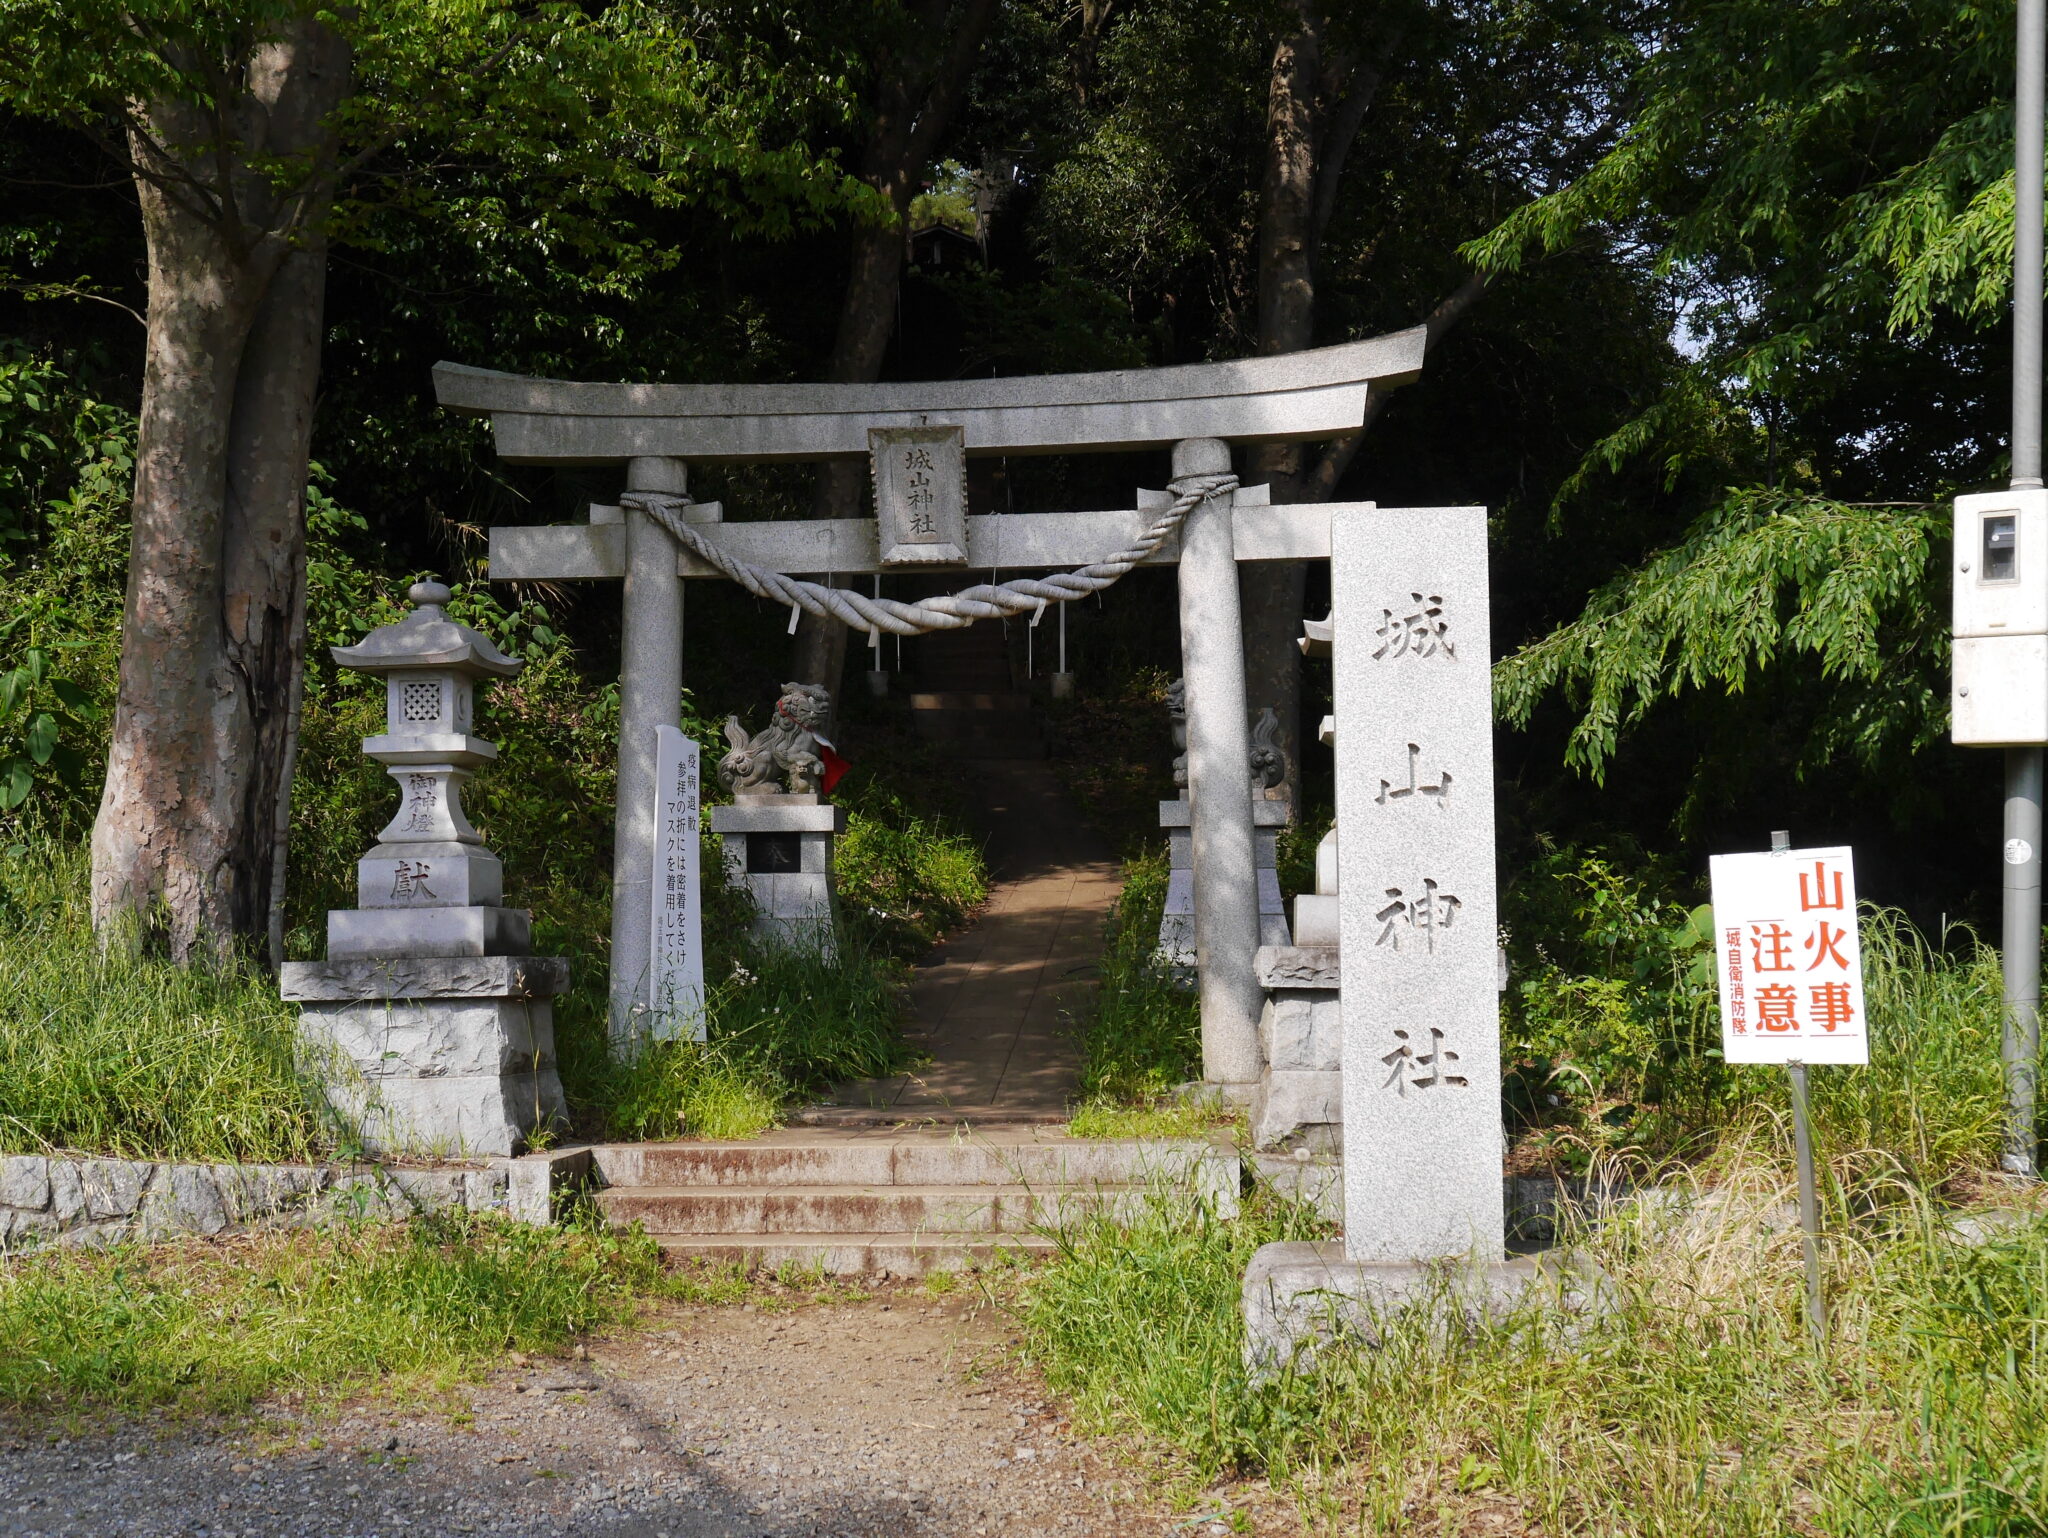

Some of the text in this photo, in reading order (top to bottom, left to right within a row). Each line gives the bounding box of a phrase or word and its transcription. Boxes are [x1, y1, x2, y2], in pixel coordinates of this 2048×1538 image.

[905, 448, 937, 535] 城山神社
[400, 773, 437, 833] 御神燈
[686, 752, 697, 833] 疫病退散
[1371, 592, 1470, 1099] 城山神社
[676, 760, 687, 966] 参拝の折には密着をさけ
[1725, 931, 1747, 1035] 城自衛消防隊
[1749, 923, 1801, 1033] 注意
[1798, 861, 1855, 1033] 山火事
